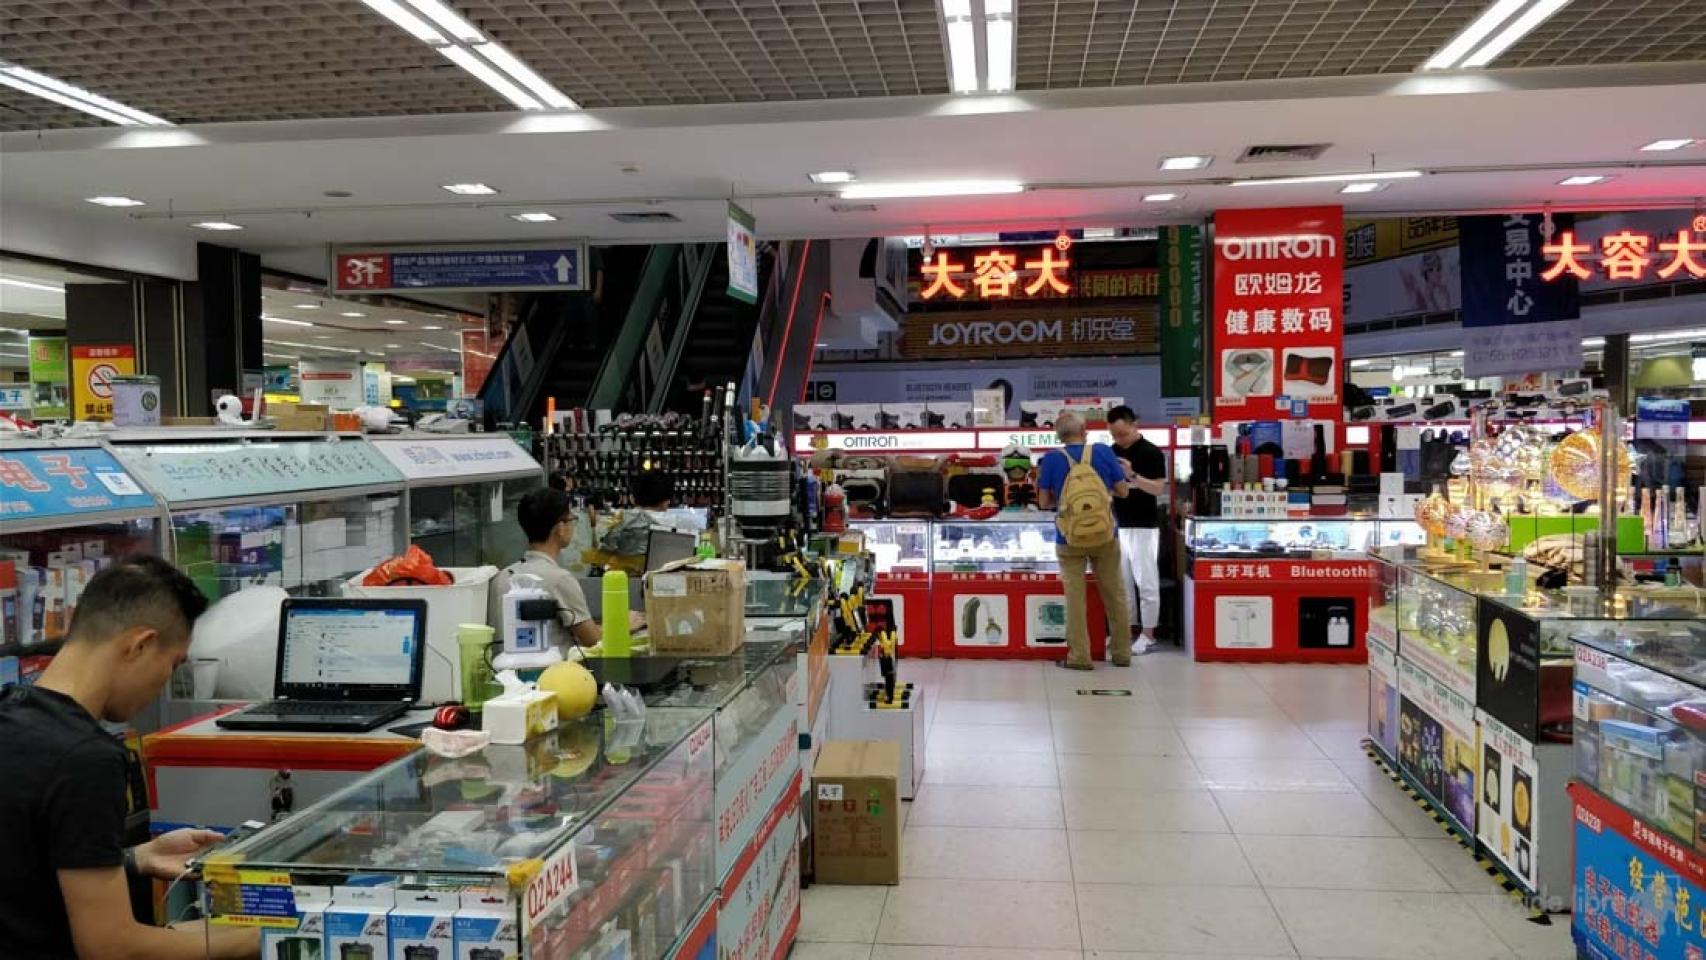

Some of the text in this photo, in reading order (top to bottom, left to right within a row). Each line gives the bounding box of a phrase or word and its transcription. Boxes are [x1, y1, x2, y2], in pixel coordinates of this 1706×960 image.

[1542, 230, 1706, 281] 大容大
[346, 257, 384, 285] 3F
[920, 250, 1071, 299] 大容大
[1235, 271, 1323, 296] 欧姆龙
[928, 316, 1137, 346] JOYROOM 机乐堂
[1225, 307, 1333, 335] 健康数码
[1210, 564, 1271, 578] 蓝牙耳机
[529, 852, 573, 918] Q2A244
